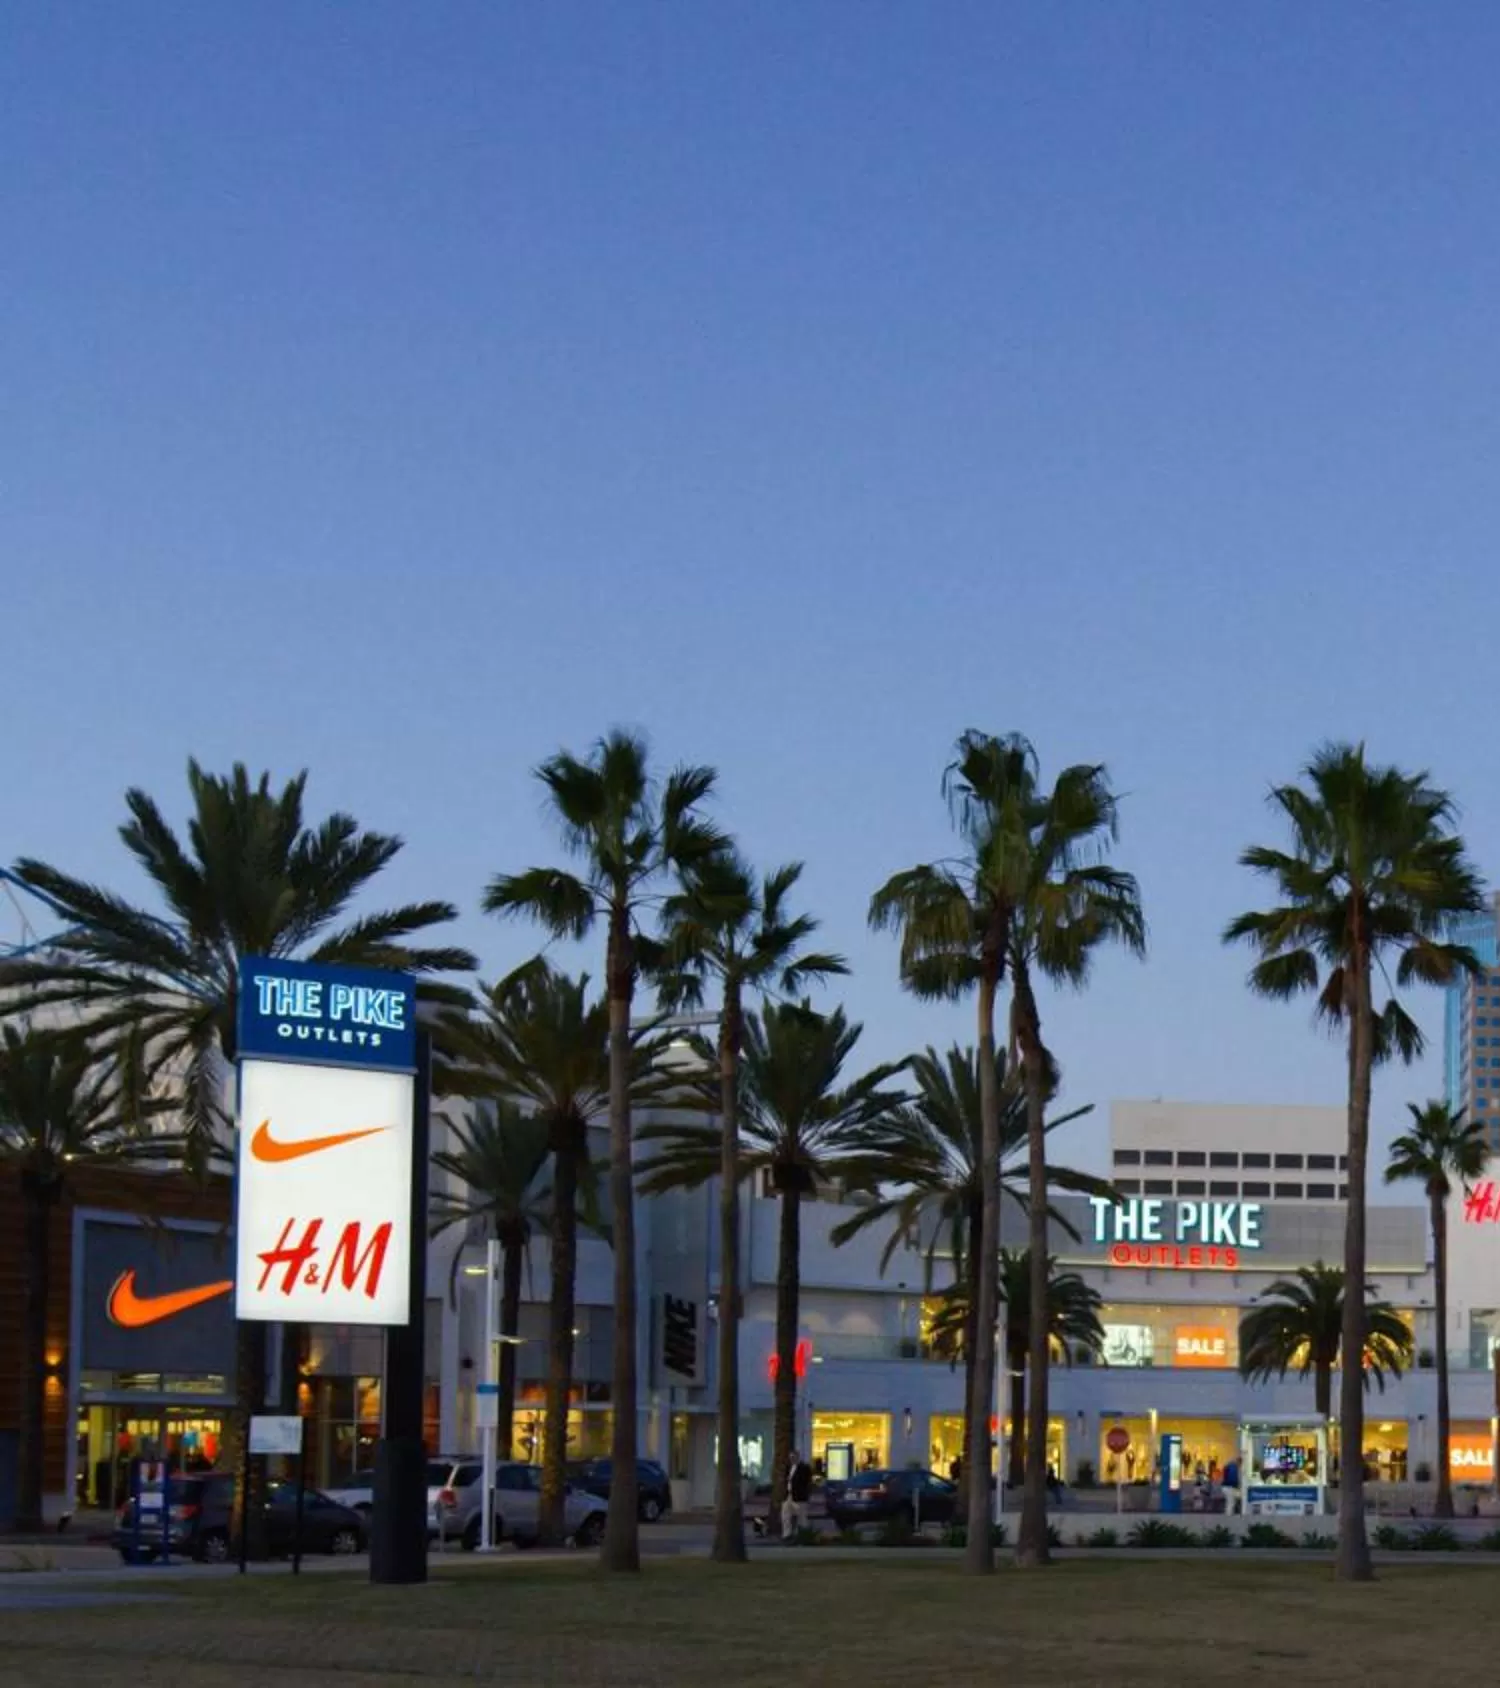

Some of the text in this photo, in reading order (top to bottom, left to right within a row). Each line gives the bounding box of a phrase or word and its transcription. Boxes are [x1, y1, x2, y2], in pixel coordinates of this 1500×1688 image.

[253, 975, 406, 1031] THE PIKE
[277, 1023, 382, 1047] OUTLETS
[1089, 1197, 1260, 1248] THE PIKE
[256, 1217, 393, 1300] H&M
[1111, 1244, 1238, 1268] OUTLETS
[664, 1294, 696, 1379] NIKE
[1176, 1338, 1226, 1356] SALE
